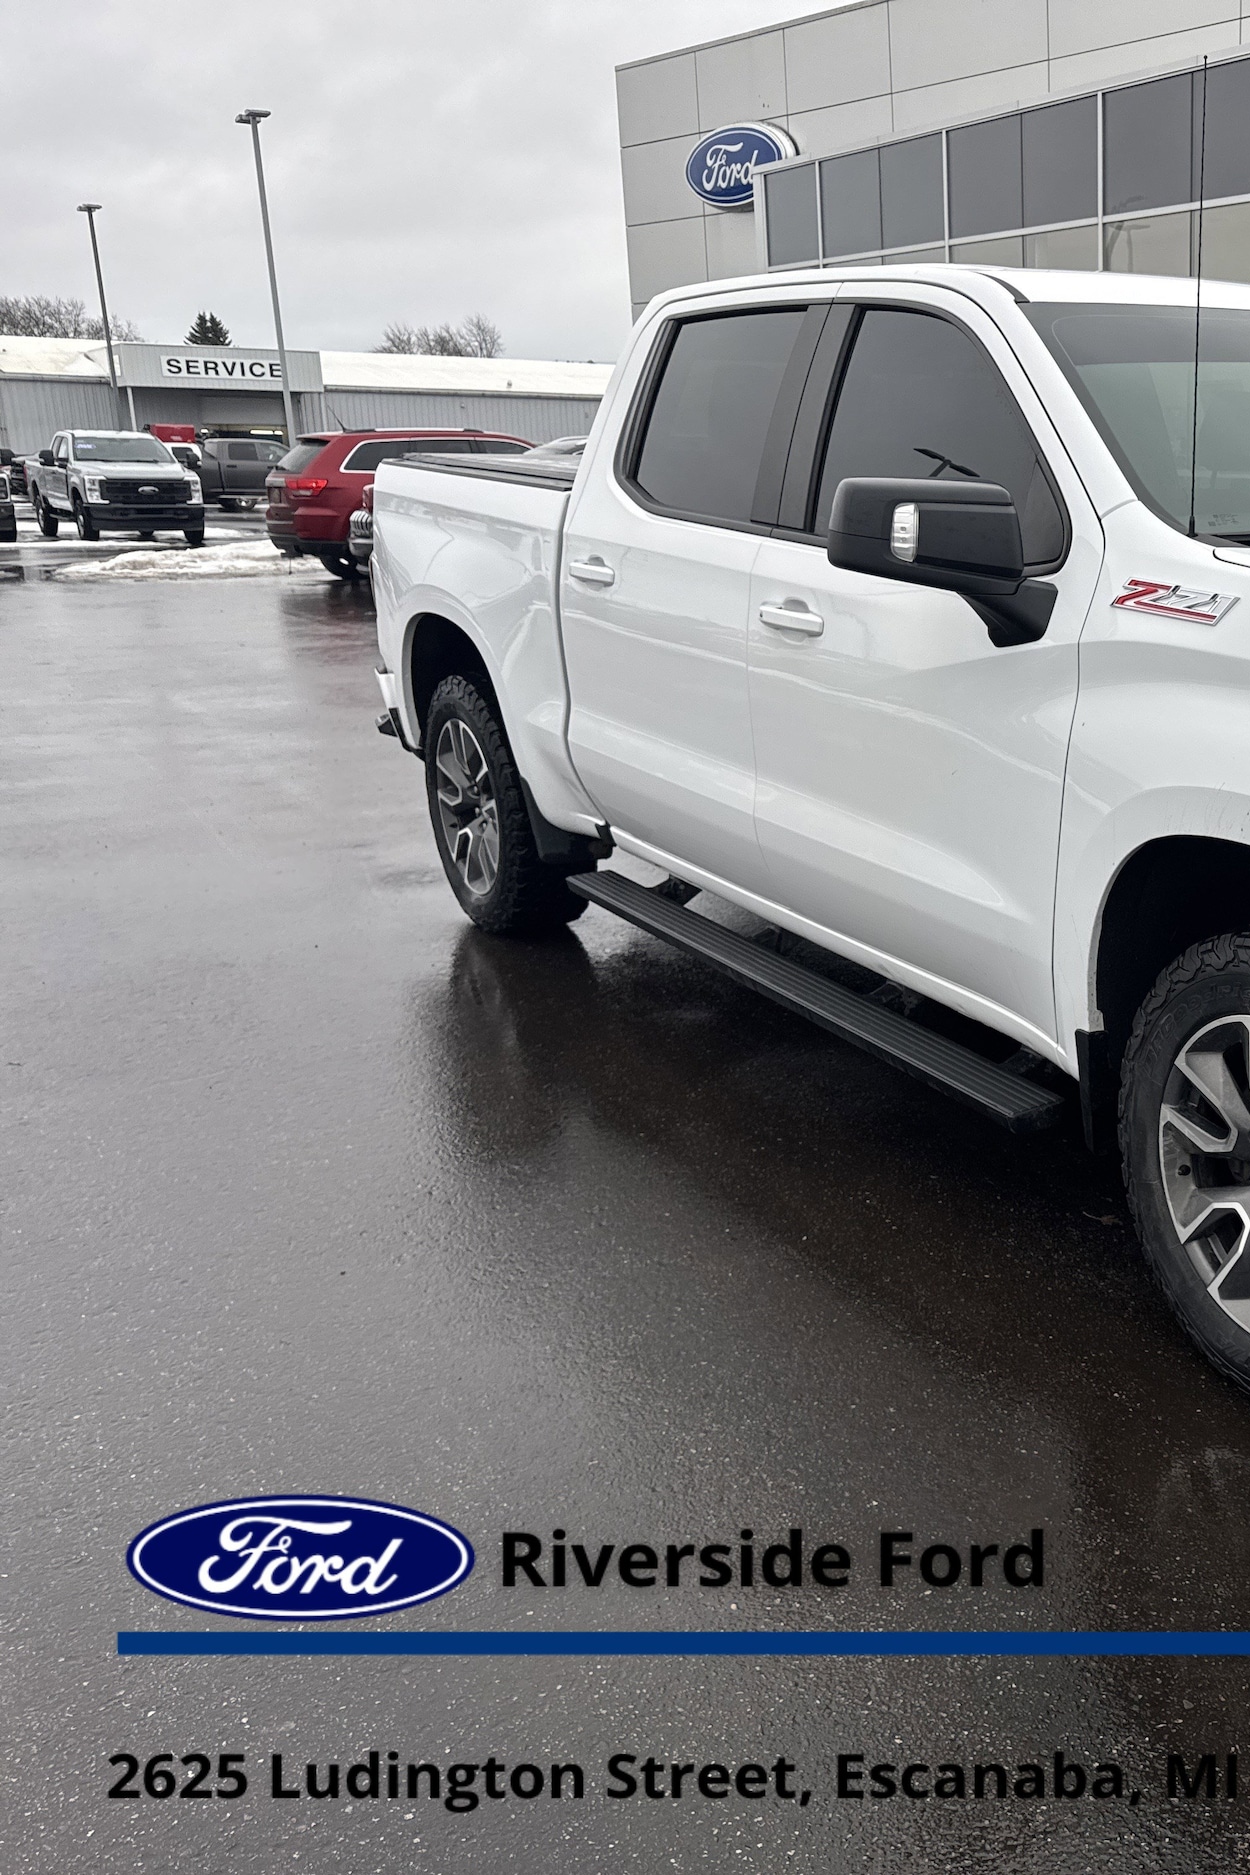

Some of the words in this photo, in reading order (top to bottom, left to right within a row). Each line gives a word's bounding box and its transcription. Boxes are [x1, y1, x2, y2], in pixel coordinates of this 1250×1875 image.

[702, 142, 759, 192] Ford
[166, 358, 282, 378] SERVICE
[1110, 577, 1241, 626] Z71
